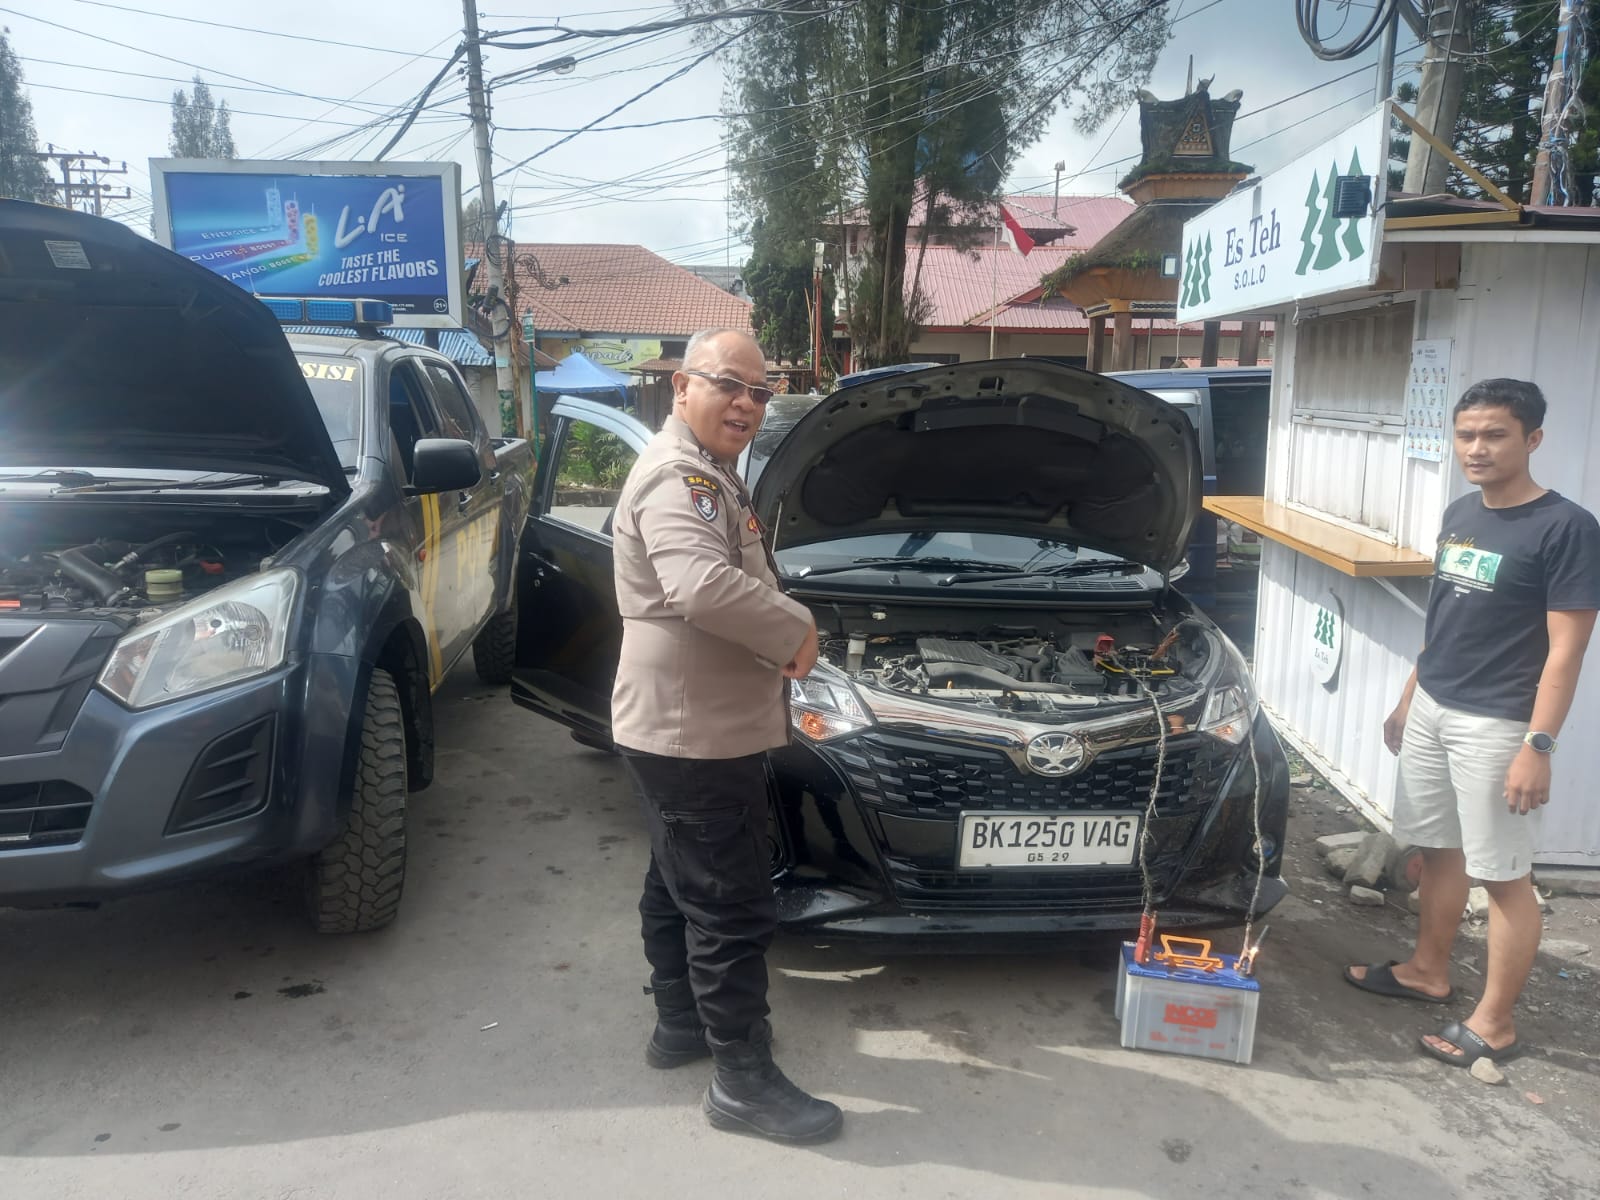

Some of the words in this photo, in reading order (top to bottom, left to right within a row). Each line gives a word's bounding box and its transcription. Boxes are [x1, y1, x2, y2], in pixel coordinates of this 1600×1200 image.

[380, 233, 408, 242] ICE
[1224, 227, 1244, 267] Es
[1249, 208, 1281, 258] Teh
[341, 253, 375, 270] TASTE
[377, 249, 401, 265] THE
[318, 268, 369, 287] COOLEST
[371, 259, 439, 282] FLAVORS
[1083, 821, 1131, 847] VAG
[1051, 852, 1070, 862] 29
